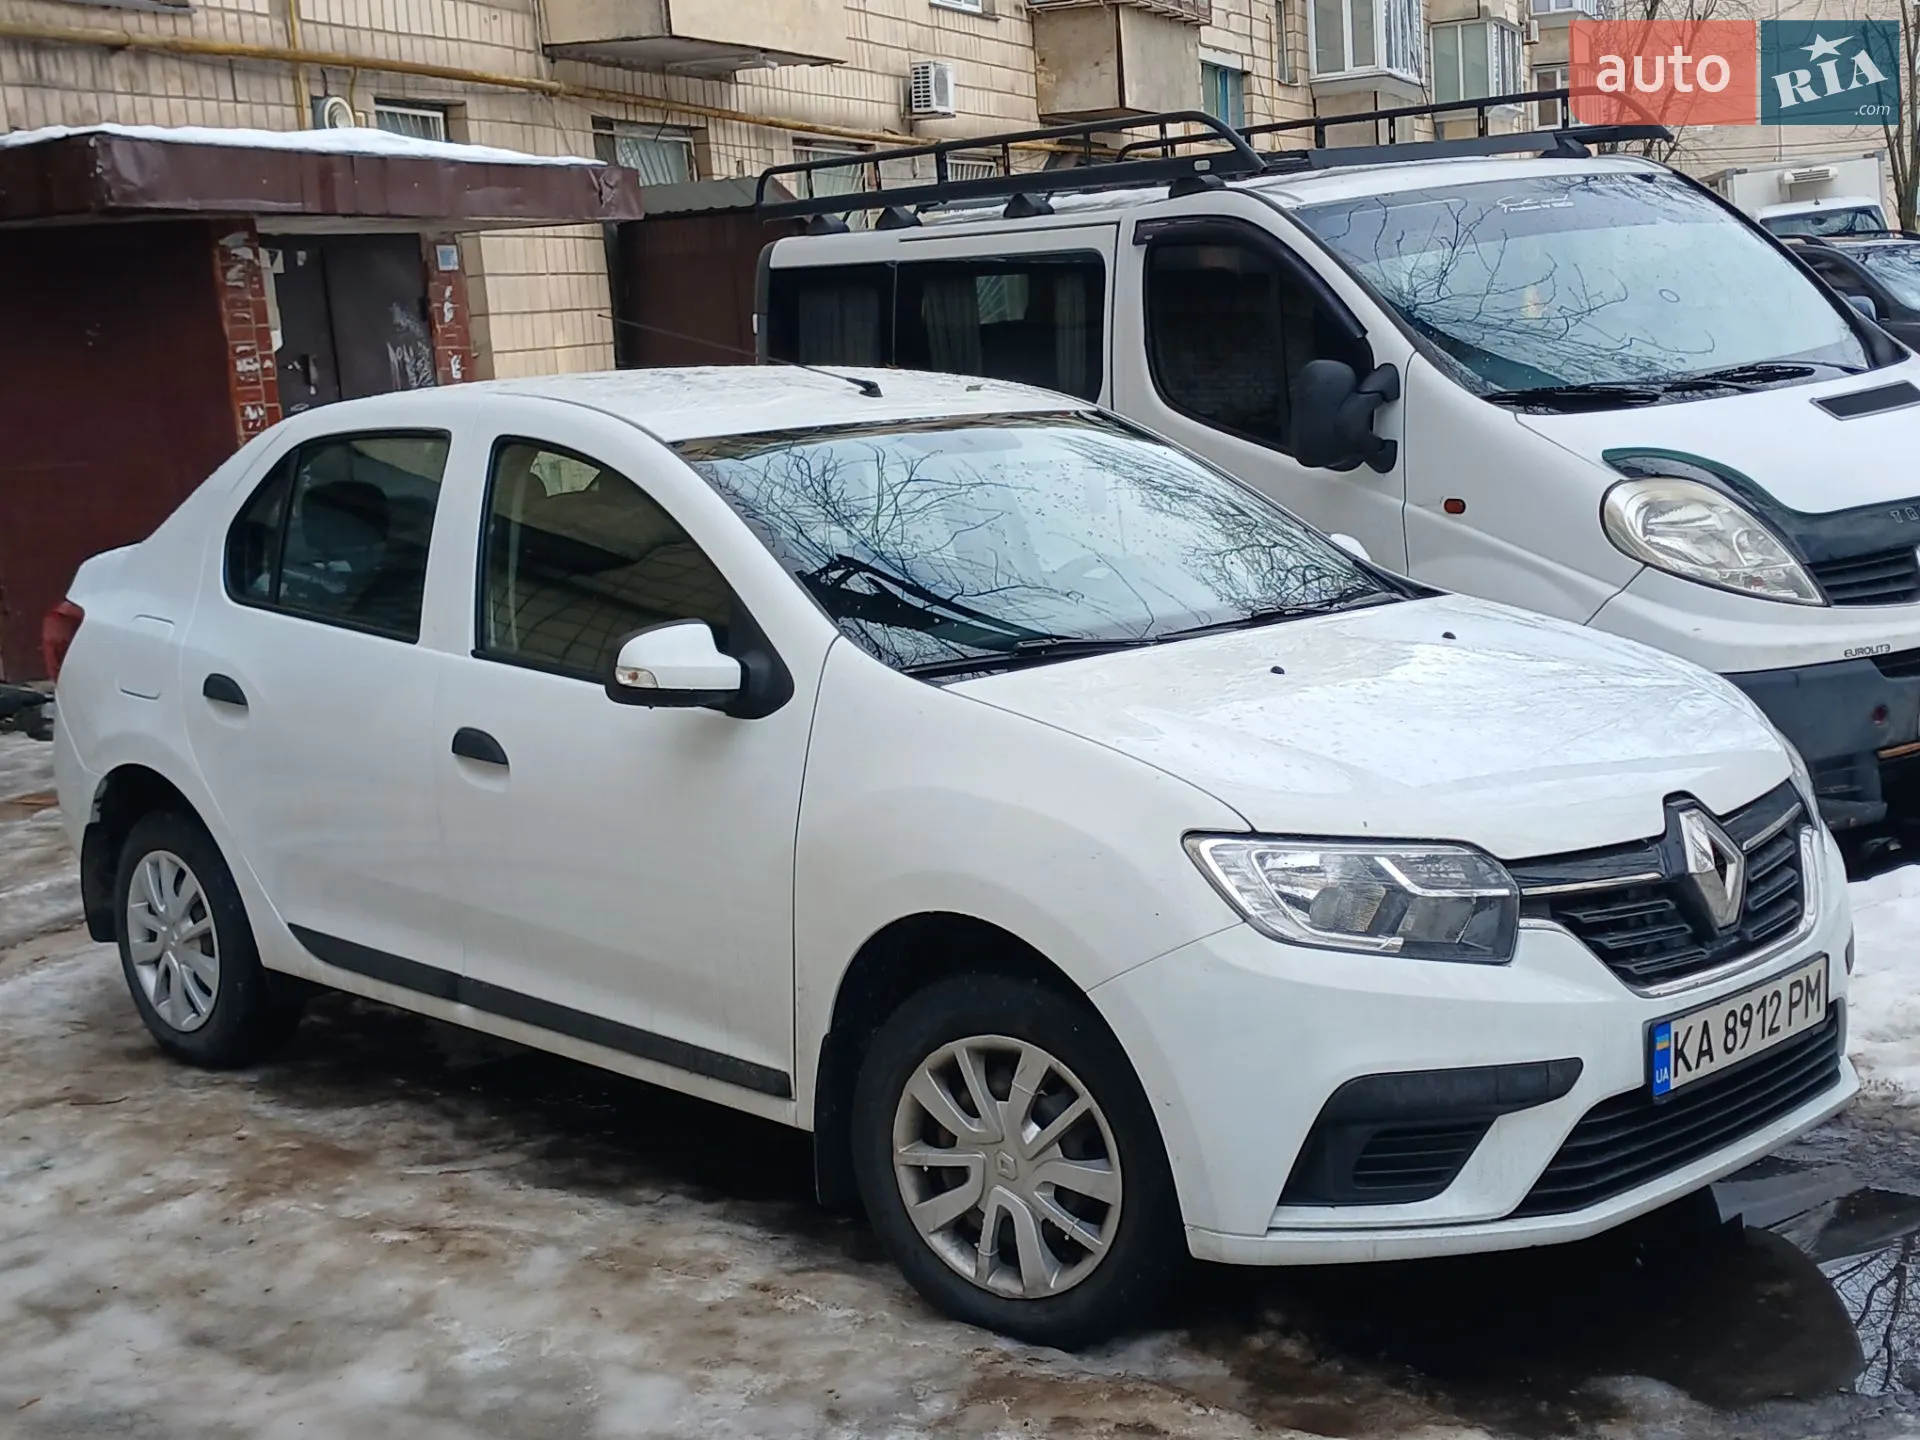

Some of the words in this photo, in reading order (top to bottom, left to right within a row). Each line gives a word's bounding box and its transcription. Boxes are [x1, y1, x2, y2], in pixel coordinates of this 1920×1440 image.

[1673, 1020, 1715, 1078] KA
[1723, 990, 1782, 1055] 8912
[1787, 969, 1822, 1027] PM
[1655, 1067, 1670, 1084] UA
